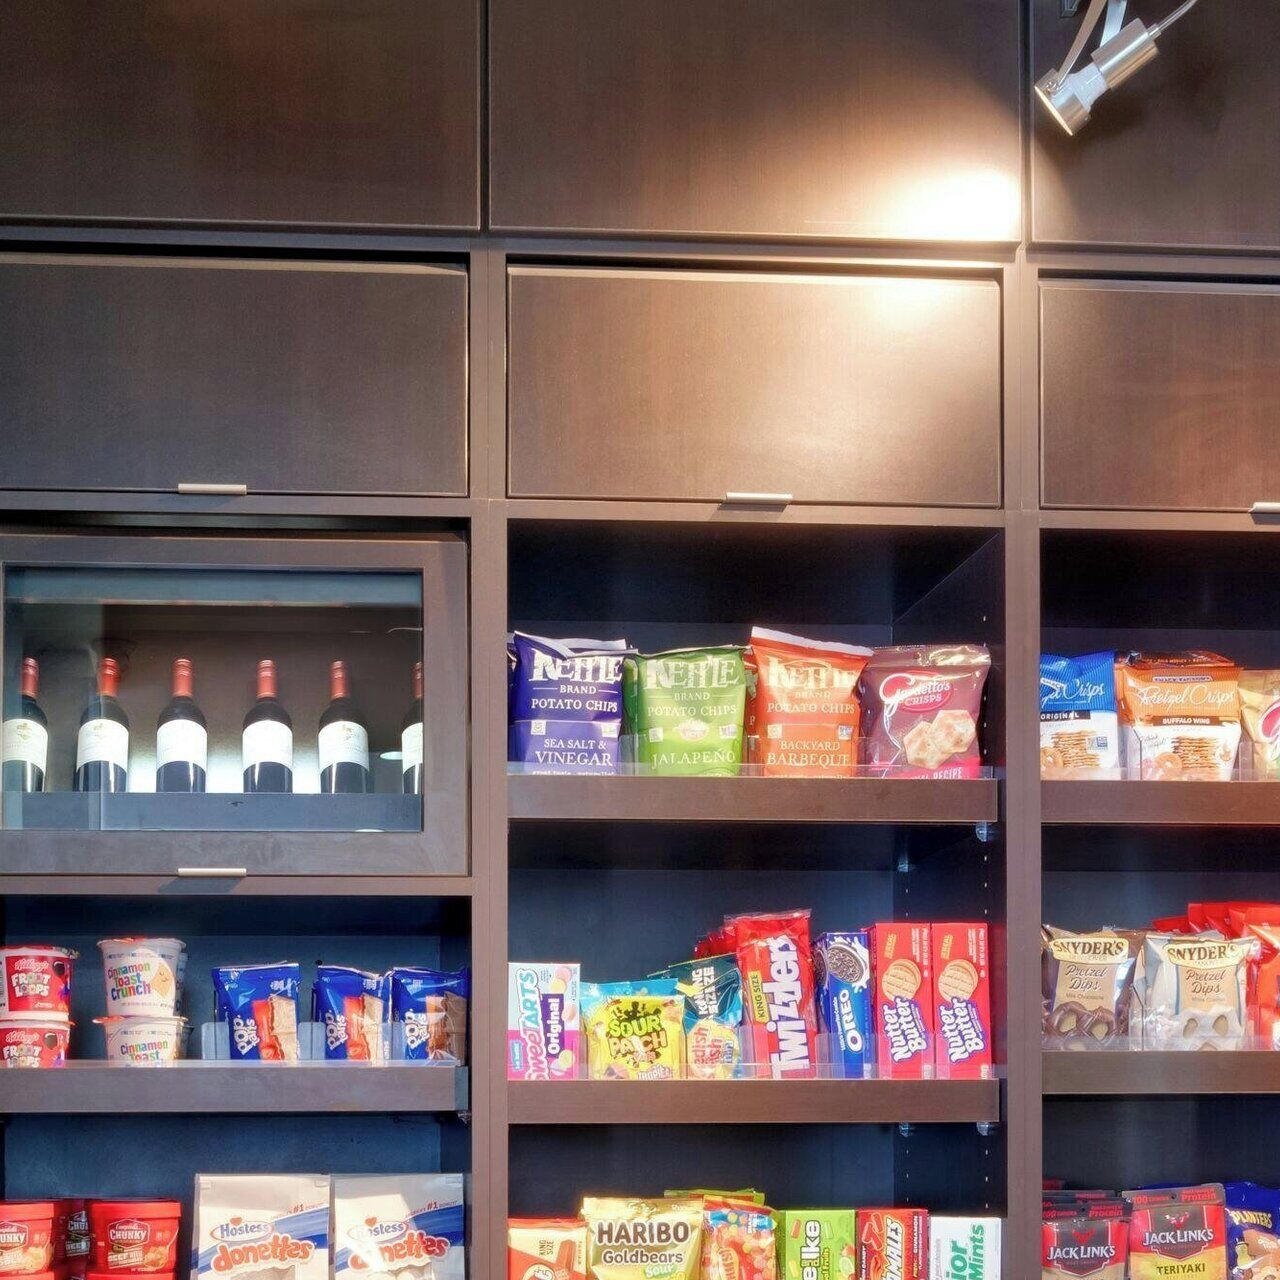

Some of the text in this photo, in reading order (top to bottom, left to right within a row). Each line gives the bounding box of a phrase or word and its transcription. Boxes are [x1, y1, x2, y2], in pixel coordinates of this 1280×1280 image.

[645, 655, 738, 689] KETTLE
[560, 685, 597, 695] BRAND
[674, 692, 710, 701] BRAND
[795, 690, 831, 699] BRAND
[532, 698, 618, 712] POTATO CHIPS
[904, 693, 942, 706] CRISPS
[648, 705, 737, 717] POTATO CHIPS
[767, 702, 856, 714] POTATO CHIPS
[1040, 711, 1079, 721] ORIGINAL
[1163, 717, 1211, 725] BUFFALO WING
[544, 738, 607, 750] SEA SALT &
[780, 740, 841, 751] BACKYARD
[535, 751, 613, 767] VINEGAR
[652, 747, 736, 769] JALAPEÑO
[767, 752, 850, 767] BARBEQUE
[1053, 940, 1125, 956] SNYDER'S
[1167, 944, 1236, 961] SNYDER'S
[12, 971, 51, 985] FROOT
[107, 961, 151, 979] Cinnamon
[1065, 964, 1109, 978] Pretzel
[1185, 969, 1226, 982] Pretzel
[114, 971, 142, 988] Toast
[1069, 976, 1101, 992] Dips
[1191, 981, 1221, 994] Dips
[15, 983, 50, 998] LOOPS
[110, 982, 151, 1001] Crunch
[750, 974, 765, 1018] KING SIZE
[763, 936, 809, 1079] Twizzlers
[548, 998, 563, 1054] Original
[609, 1015, 662, 1036] SOUR
[839, 989, 863, 1052] OREO
[894, 996, 927, 1051] Butter
[951, 996, 984, 1051] Butter
[882, 1004, 906, 1063] Nutter
[938, 1004, 970, 1063] Nutter
[120, 1039, 168, 1055] Cinnamon
[607, 1030, 668, 1056] PATCH
[2, 1045, 42, 1058] FROOT
[1231, 1208, 1273, 1229] PLANTERS
[109, 1229, 147, 1242] CHUNKY
[220, 1223, 272, 1241] Hostess
[597, 1221, 690, 1244] HARIBO
[1143, 1229, 1214, 1246] JACK LINK'S
[538, 1238, 547, 1256] KING
[546, 1238, 555, 1255] SIZE
[1047, 1245, 1115, 1261] JACK LINK'S
[214, 1239, 315, 1272] donettes
[603, 1250, 683, 1264] Goldbears
[822, 1247, 831, 1271] Fruits
[1157, 1262, 1206, 1275] TERIYAKI
